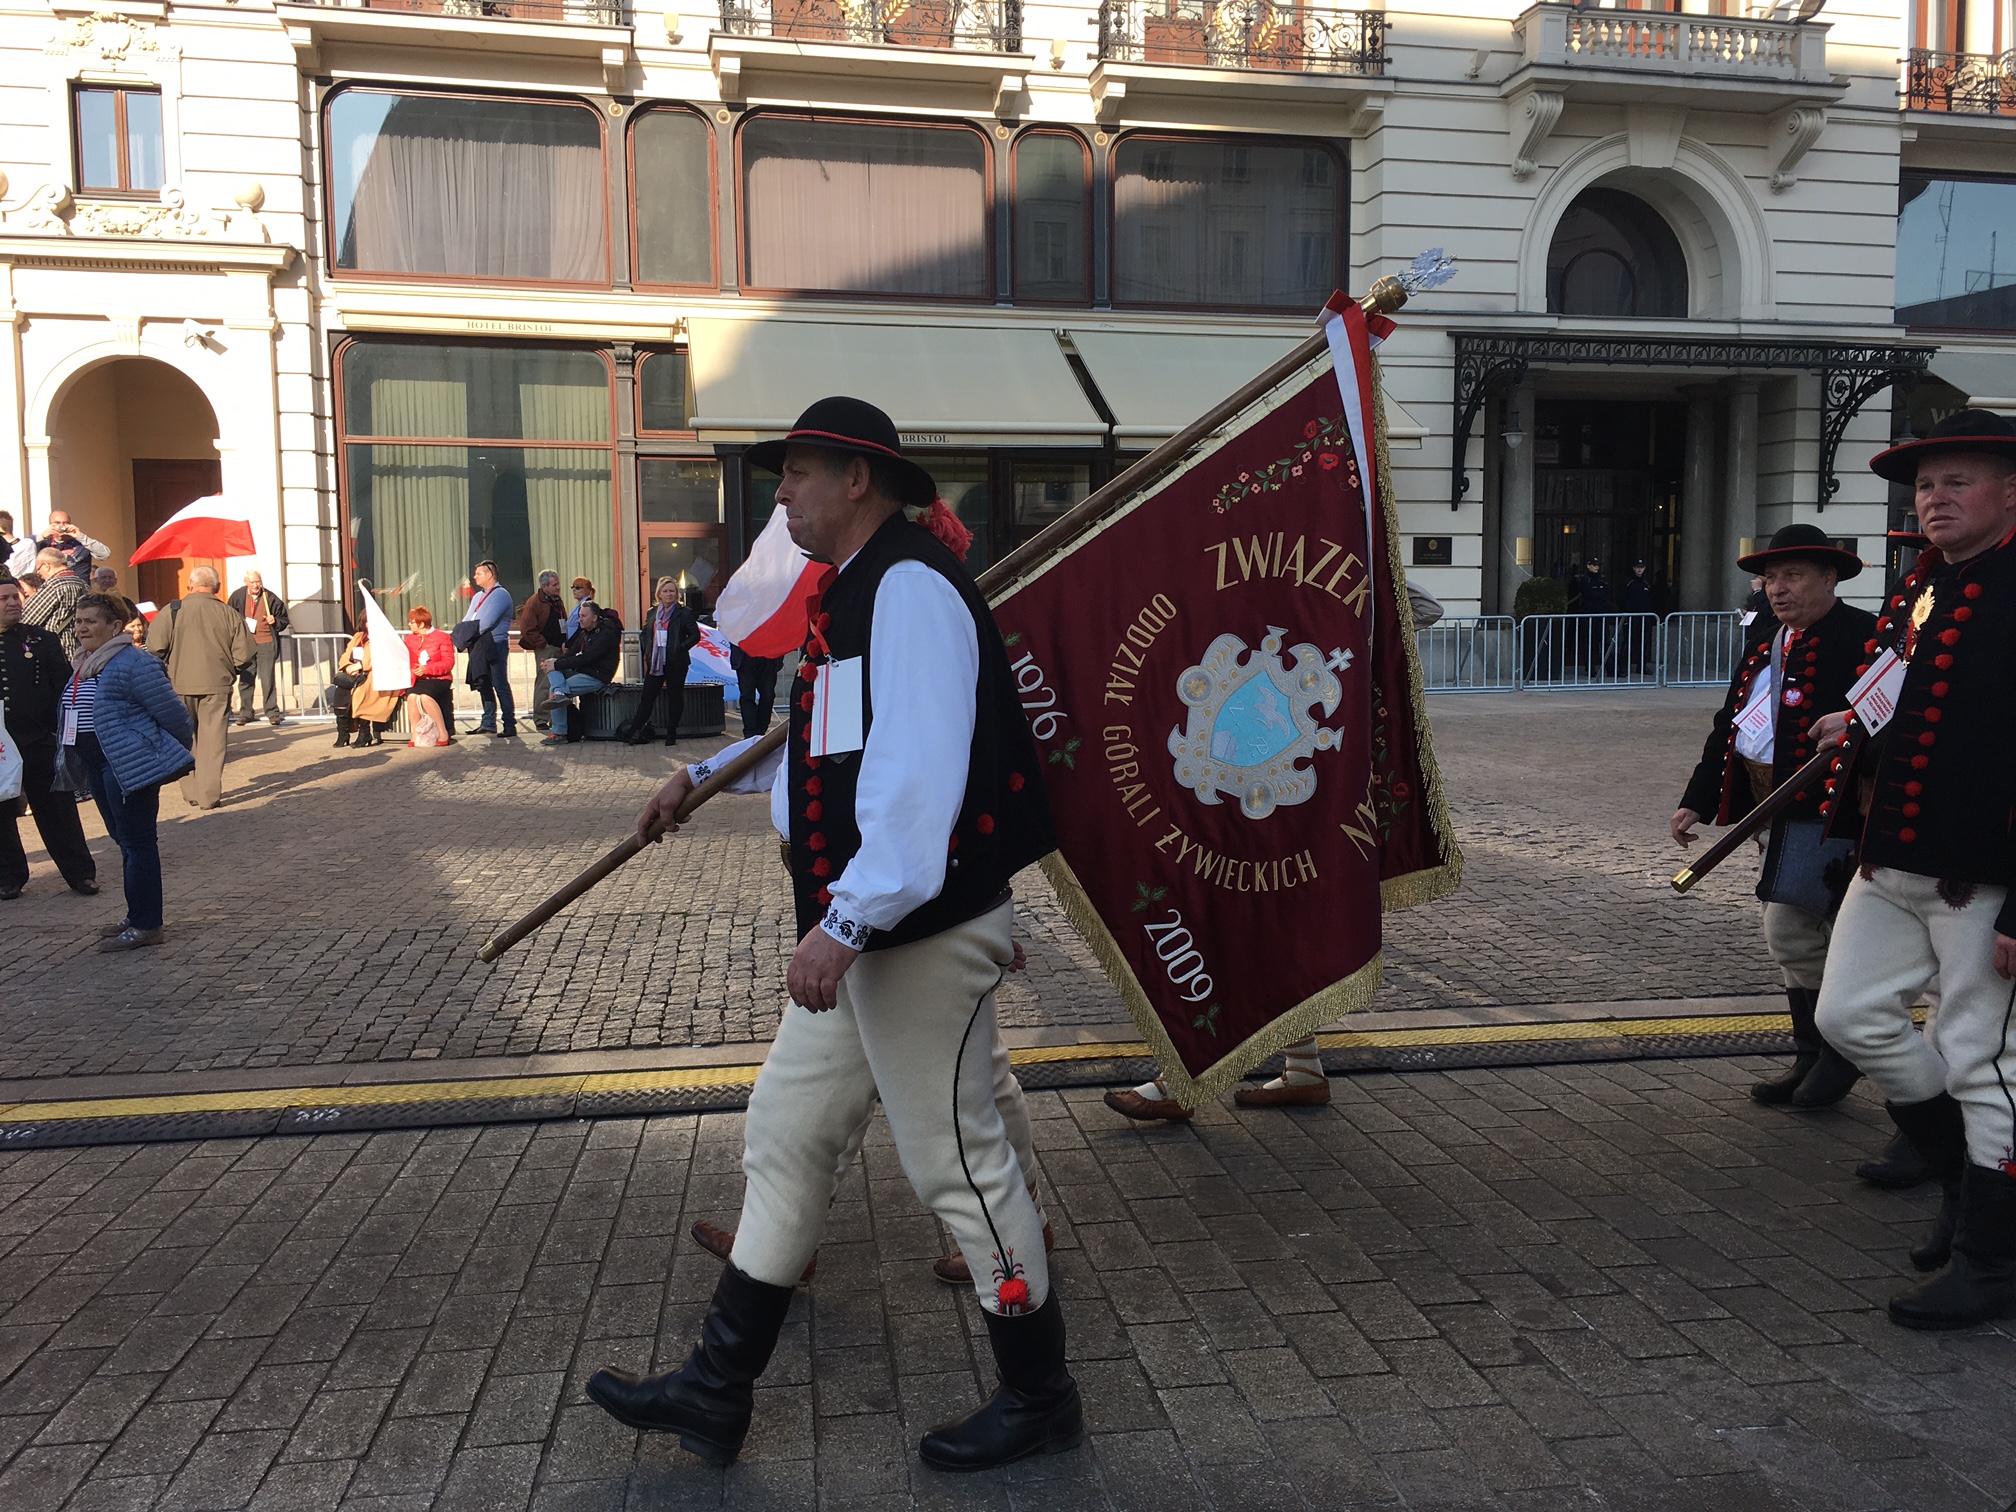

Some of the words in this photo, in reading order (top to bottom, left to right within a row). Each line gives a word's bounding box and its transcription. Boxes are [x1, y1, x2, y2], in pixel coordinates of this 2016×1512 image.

[467, 321, 505, 330] HOTEL
[507, 323, 555, 332] BRISTOL
[902, 434, 949, 443] BRISTOL
[1203, 531, 1371, 619] ZWIĄZEK
[1104, 593, 1177, 706] ODDZIAŁ
[1010, 650, 1068, 740] 1926
[1103, 725, 1161, 827] GÓRALI
[1143, 908, 1214, 1002] 2009
